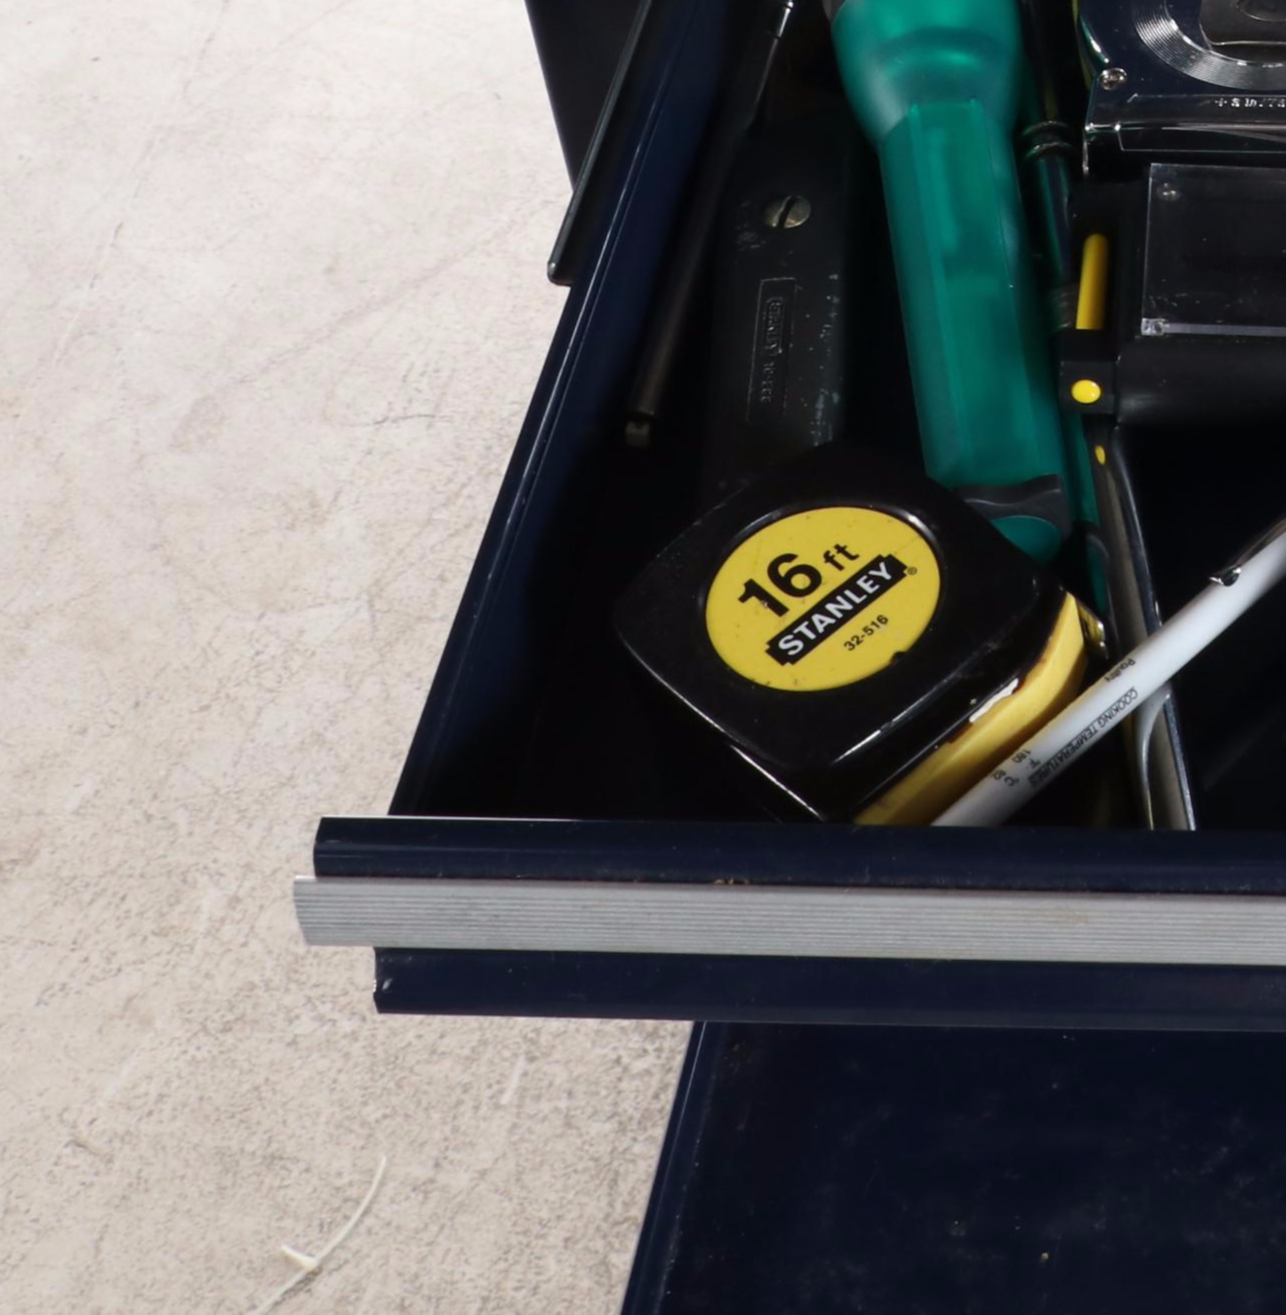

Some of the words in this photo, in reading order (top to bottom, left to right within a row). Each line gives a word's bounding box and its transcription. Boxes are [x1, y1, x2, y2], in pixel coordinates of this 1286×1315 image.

[738, 553, 822, 618] 16
[822, 544, 860, 571] ft
[778, 562, 892, 656] STANLEY
[844, 614, 889, 651] 32-516
[1104, 658, 1136, 683] Poultry
[1099, 688, 1138, 728] COOKING
[1012, 749, 1031, 764] 180
[1028, 725, 1099, 786] TEMPERATURES
